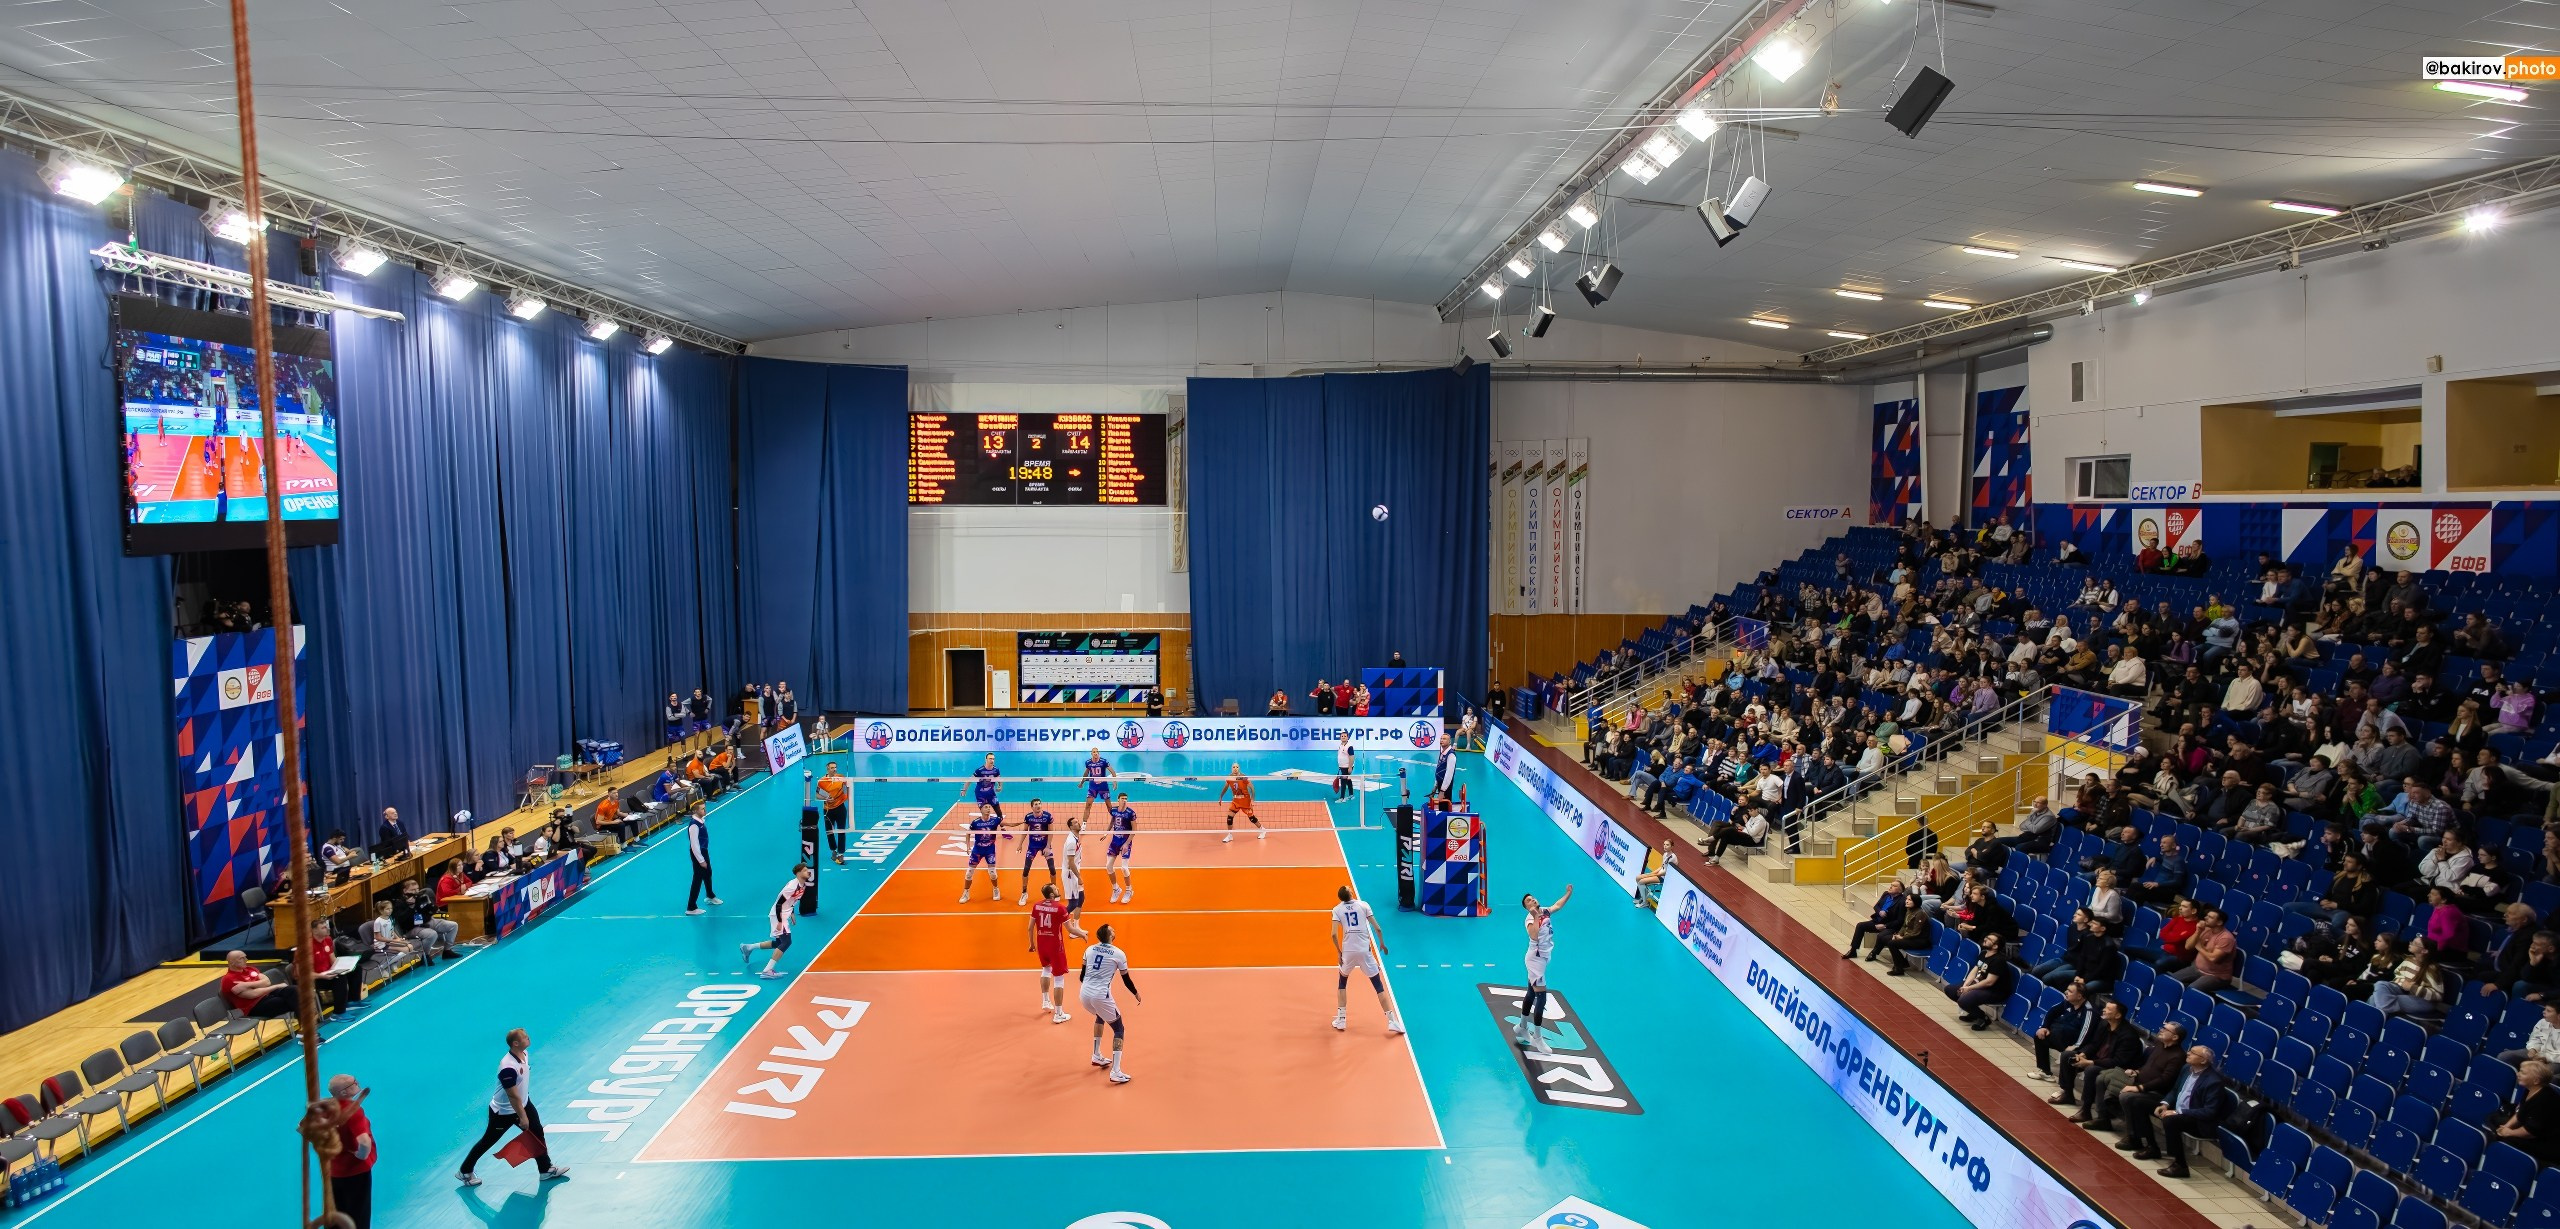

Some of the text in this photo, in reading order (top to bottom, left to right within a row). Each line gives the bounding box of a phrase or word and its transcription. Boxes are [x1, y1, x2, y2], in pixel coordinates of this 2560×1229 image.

[983, 436, 1004, 449] 13
[1032, 439, 1041, 449] 2
[1070, 436, 1090, 449] 14
[1009, 466, 1053, 480] 19:48
[2131, 486, 2186, 500] СЕКТОР
[1786, 509, 1838, 518] СЕКТОР
[1508, 489, 1517, 608] ОЛИМПИЙСКИЙ
[1528, 488, 1538, 609] ОЛИМПИЙСКИЙ
[1553, 487, 1561, 607] ОЛИМПИЙСКИЙ
[2451, 556, 2487, 571] ВФВ
[895, 726, 1110, 742] ВОЛЕЙБОЛ-ОРЕНБУРГ.РФ
[1192, 725, 1403, 742] ВОЛЕЙБОЛ-ОРЕНБУРГ.РФ
[1400, 835, 1414, 881] PARI
[1039, 912, 1052, 929] 14
[1345, 911, 1359, 927] 13
[1093, 955, 1104, 971] 9
[1487, 986, 1628, 1108] PARI
[543, 983, 762, 1143] ОРЕНБУРГ
[722, 995, 872, 1120] PARI
[1746, 959, 1991, 1193] ВОЛЕЙБОЛ-ОРЕНБУРГ.РФ
